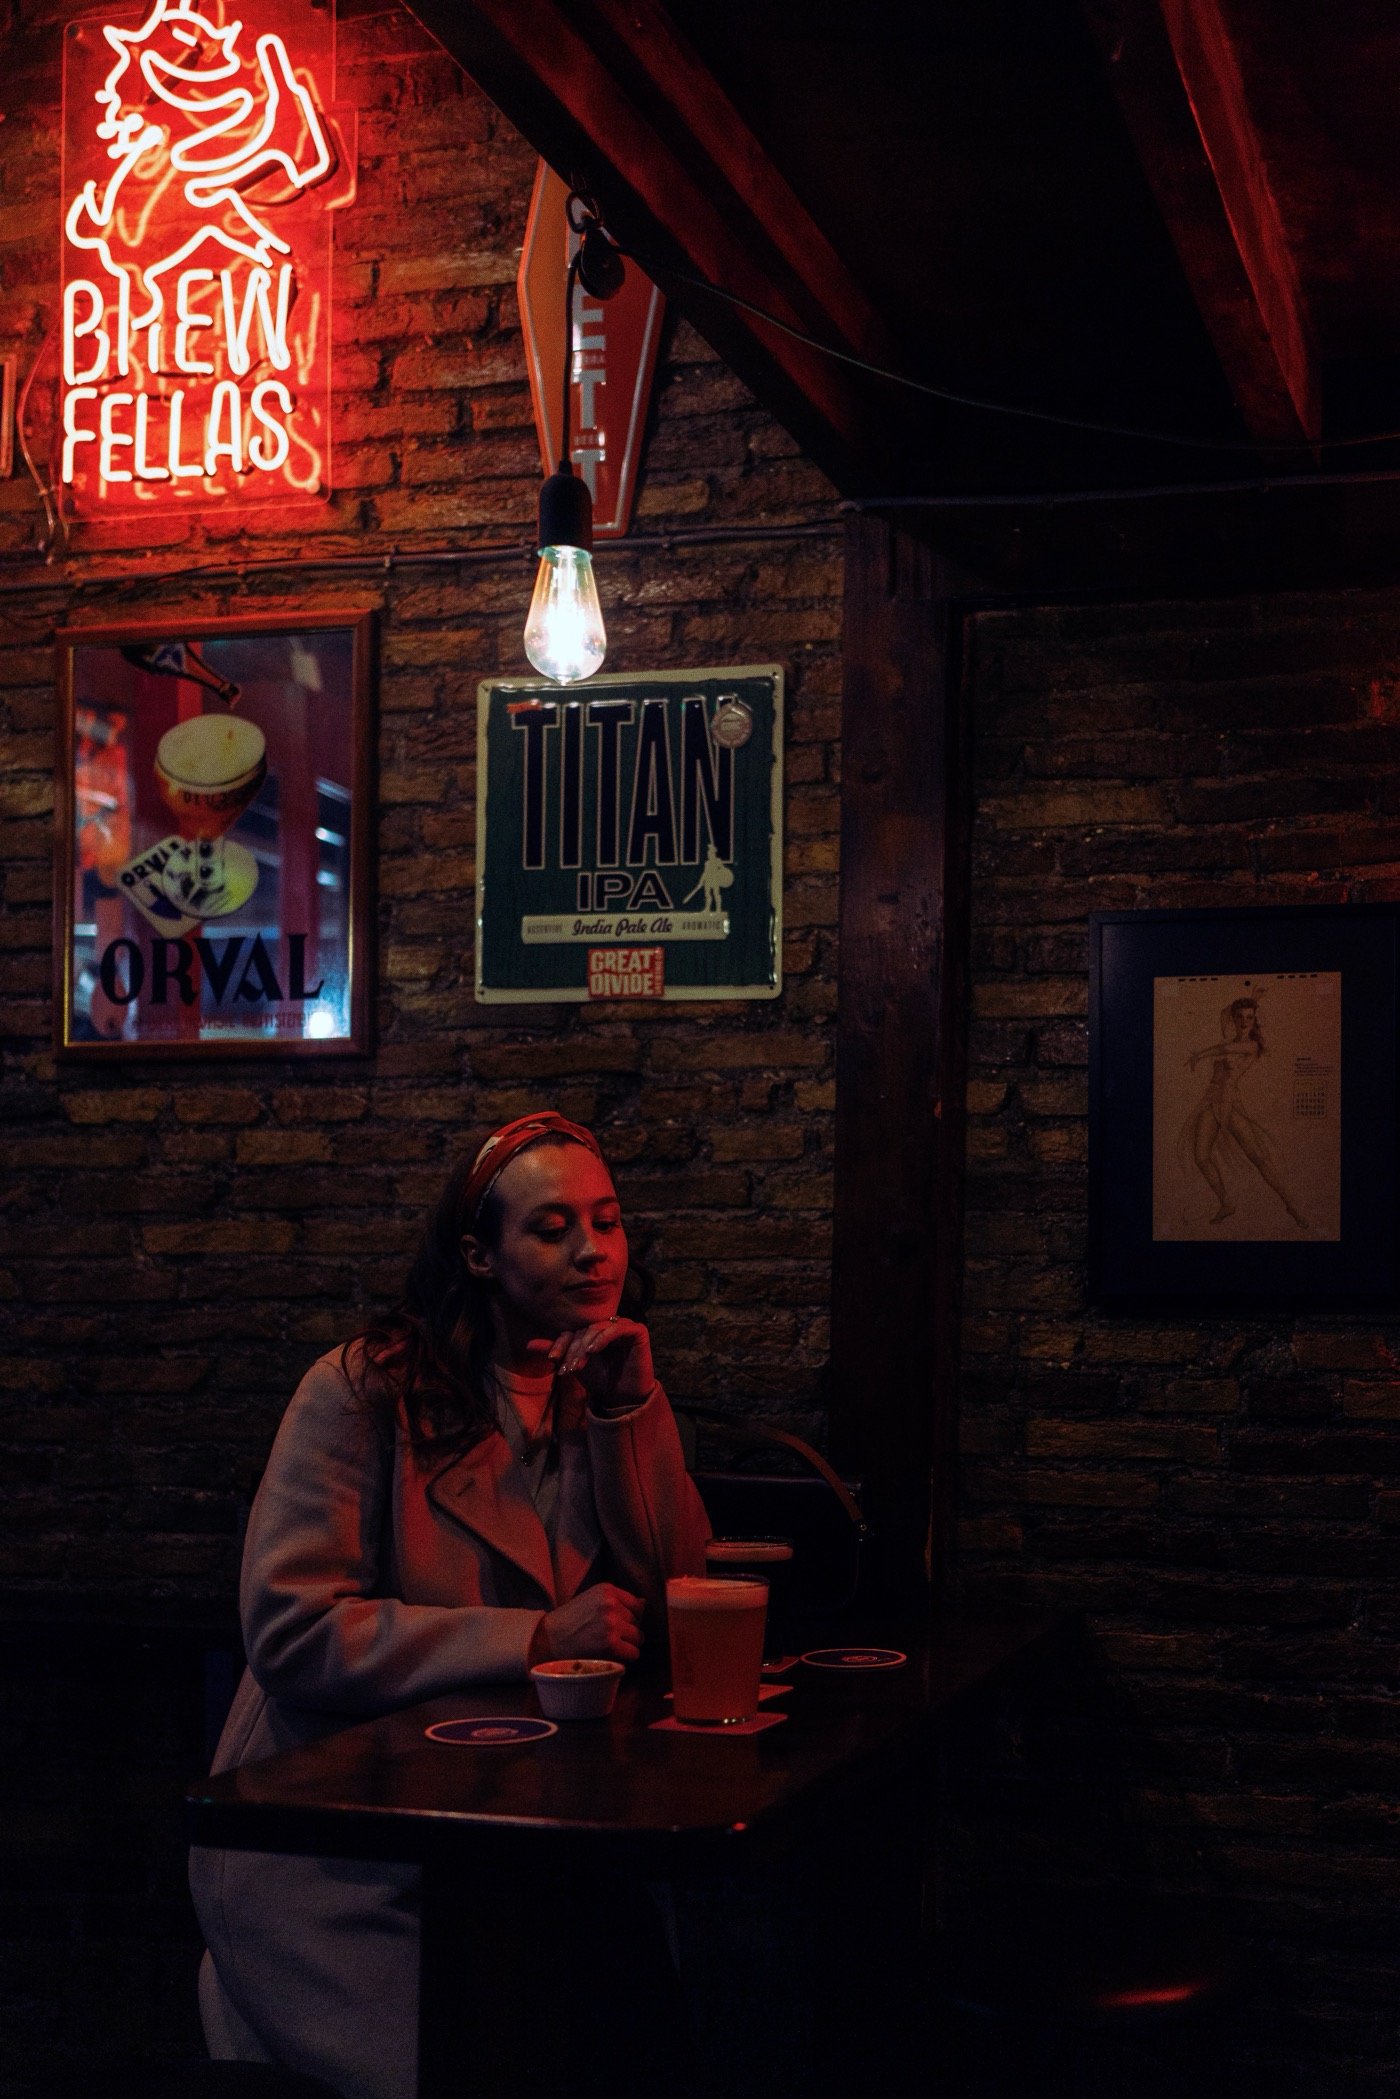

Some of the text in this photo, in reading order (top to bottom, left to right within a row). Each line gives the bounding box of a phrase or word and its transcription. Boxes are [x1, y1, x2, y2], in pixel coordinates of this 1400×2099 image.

[63, 263, 292, 386] BREW
[62, 380, 294, 484] FELLAS
[511, 695, 735, 871] TITAN
[576, 869, 675, 912] IPA
[571, 917, 673, 937] India Pale Ale
[100, 932, 325, 1006] ORVAL
[590, 949, 654, 973] GREAT
[590, 972, 654, 997] DIVIDE
